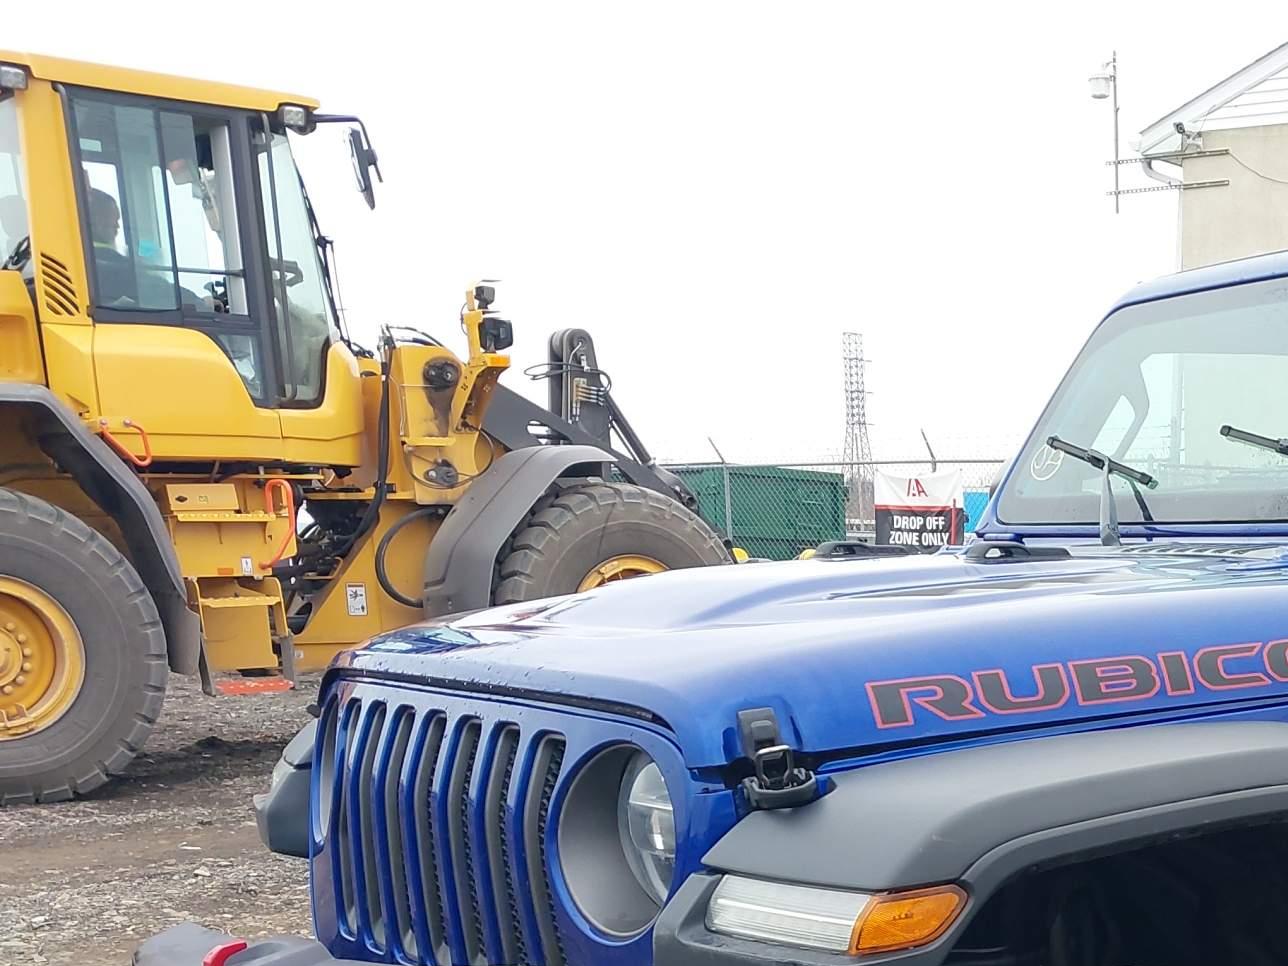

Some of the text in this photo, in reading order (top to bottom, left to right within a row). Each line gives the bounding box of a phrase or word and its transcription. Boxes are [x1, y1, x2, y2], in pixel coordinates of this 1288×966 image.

[893, 515, 945, 530] DROP OFF
[889, 531, 949, 546] ZONE ONLY
